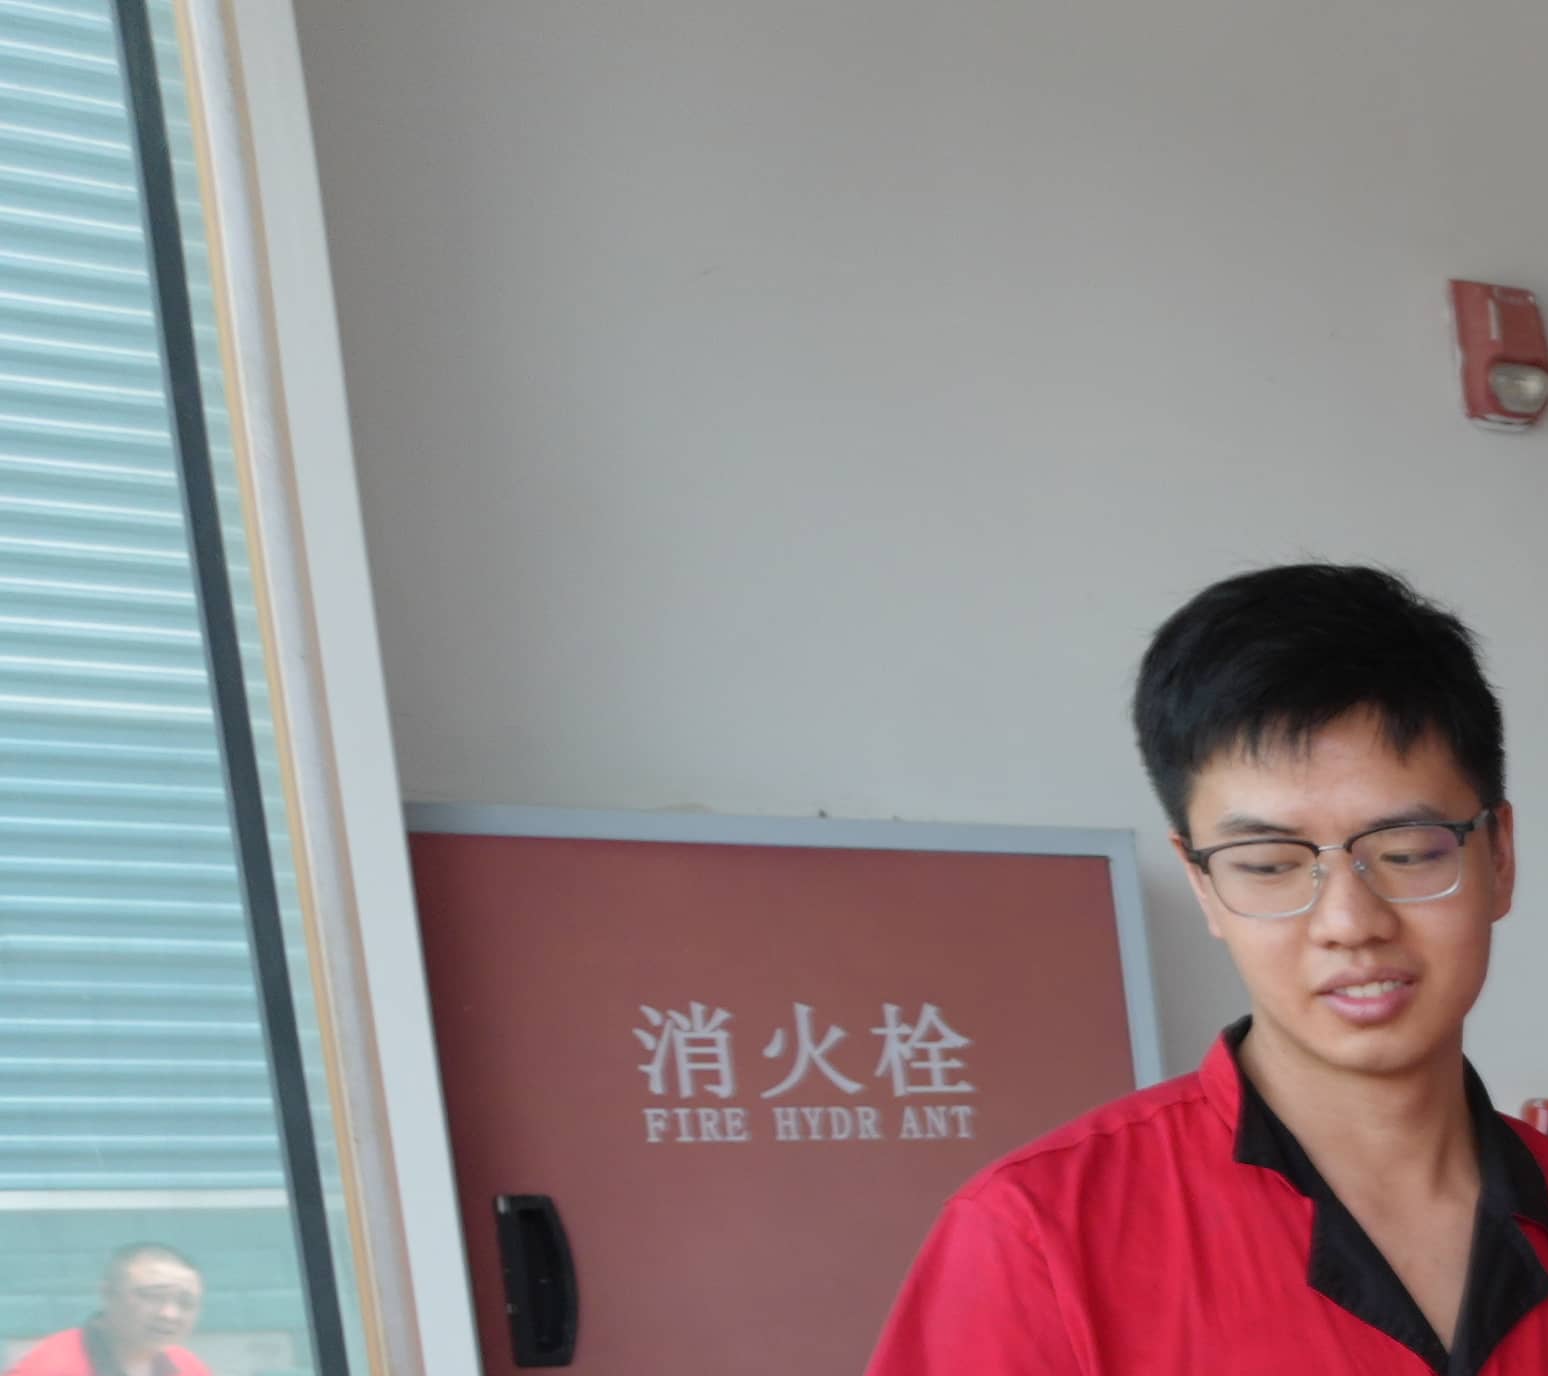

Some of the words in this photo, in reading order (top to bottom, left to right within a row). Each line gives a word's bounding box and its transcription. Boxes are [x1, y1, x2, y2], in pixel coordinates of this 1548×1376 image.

[633, 1001, 977, 1099] 消火栓
[643, 1106, 751, 1143] FIRE
[772, 1106, 884, 1141] HYDR
[899, 1105, 977, 1140] ANT
